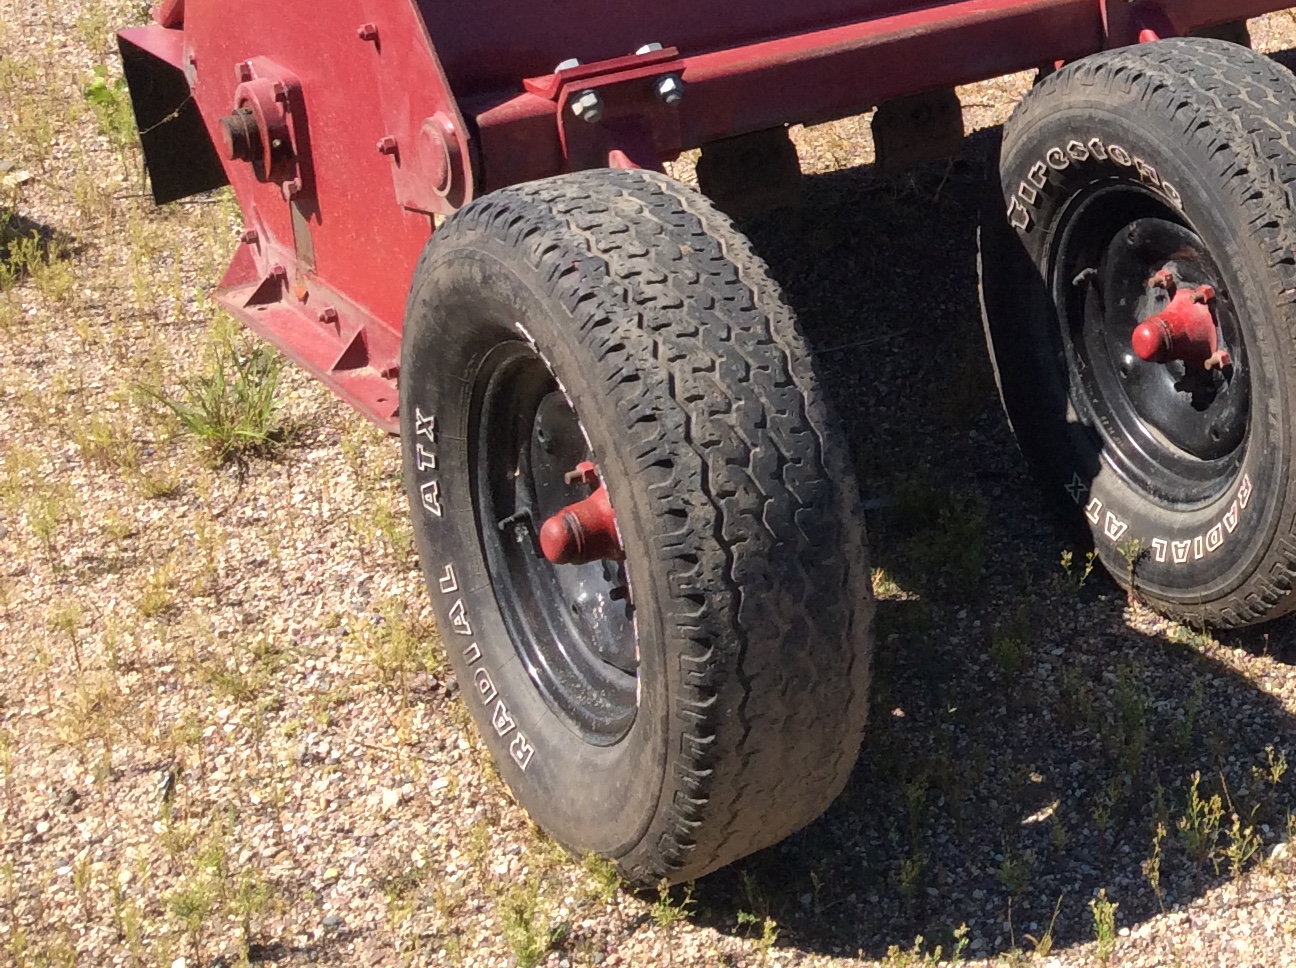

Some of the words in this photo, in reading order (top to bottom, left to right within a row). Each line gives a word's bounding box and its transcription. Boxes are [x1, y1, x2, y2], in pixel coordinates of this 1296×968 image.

[1007, 137, 1183, 231] Firestone
[415, 407, 443, 517] ATX
[1151, 473, 1253, 564] RADIAL
[439, 564, 536, 772] RADIAL
